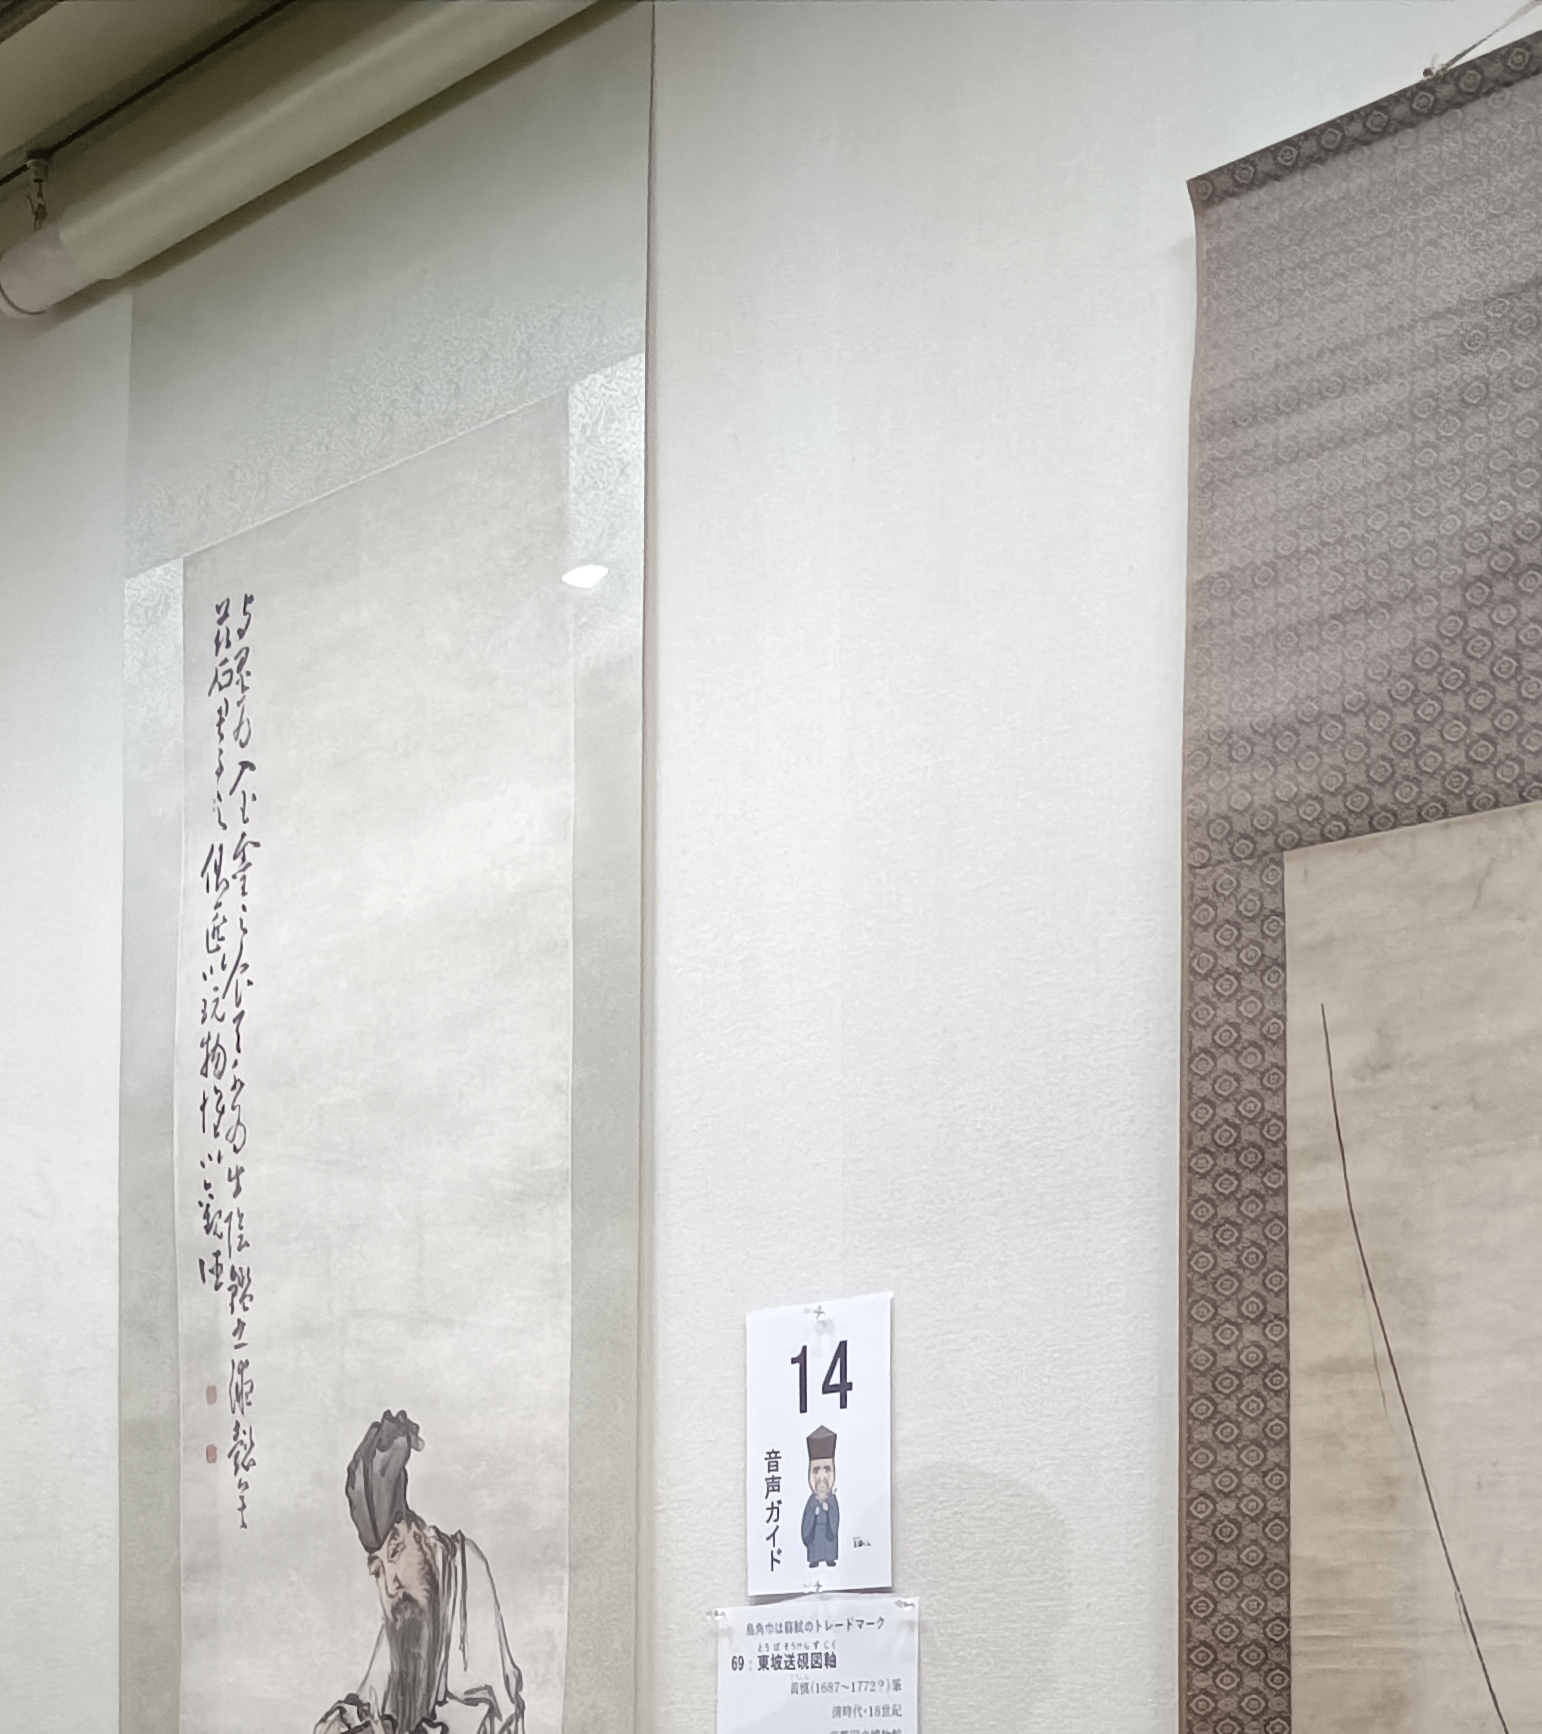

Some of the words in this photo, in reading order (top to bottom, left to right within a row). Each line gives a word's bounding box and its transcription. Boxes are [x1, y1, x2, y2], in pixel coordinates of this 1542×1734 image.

[790, 1339, 853, 1414] 14
[764, 1448, 783, 1572] 音声ガイド
